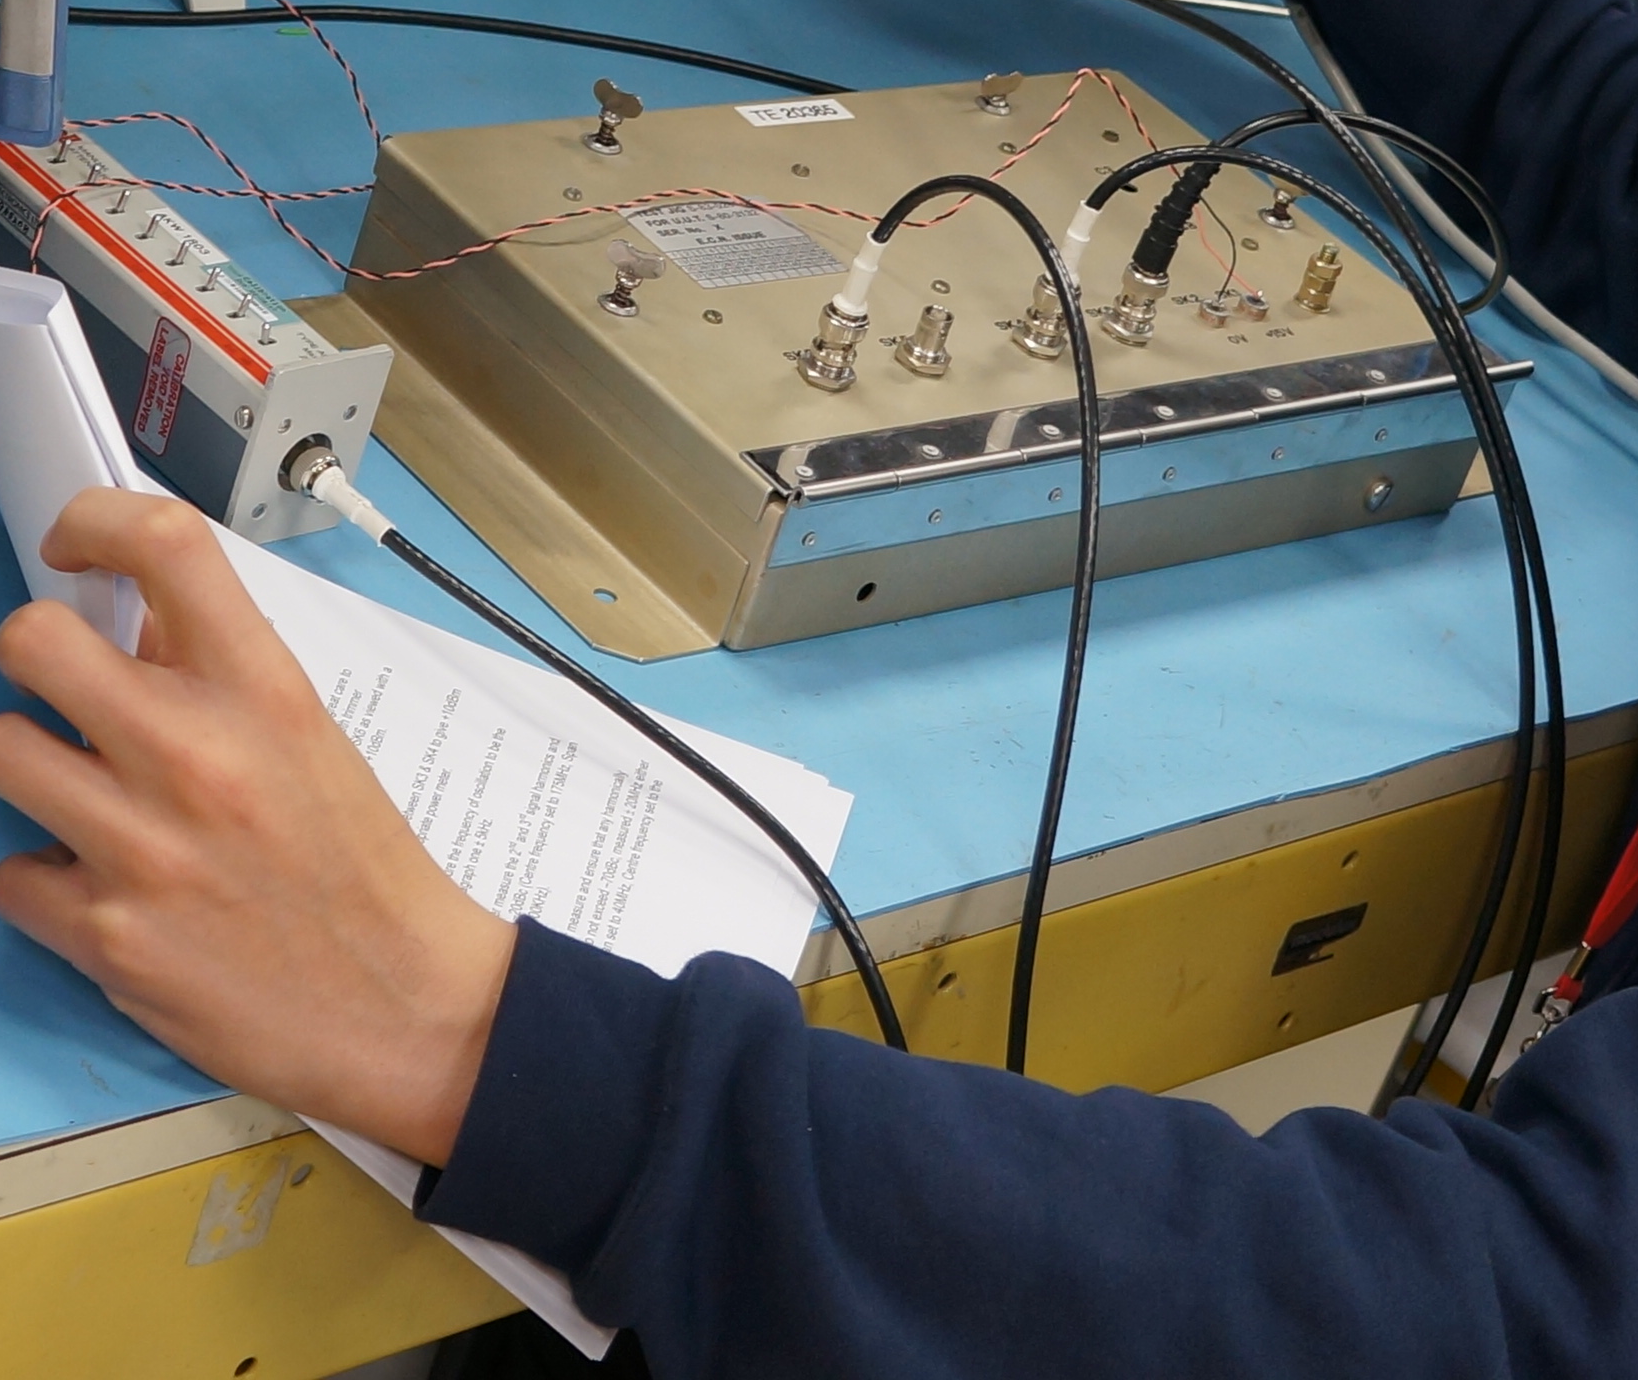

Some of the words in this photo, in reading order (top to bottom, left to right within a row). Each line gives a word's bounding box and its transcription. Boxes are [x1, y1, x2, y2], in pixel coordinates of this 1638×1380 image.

[748, 108, 782, 121] TE
[645, 217, 670, 228] FOR
[731, 231, 767, 242] ISSUE
[152, 328, 169, 367] LABEL
[138, 369, 159, 433] REMOVED
[158, 353, 184, 438] CALIBRATION
[339, 669, 352, 677] to
[376, 674, 389, 689] with
[334, 678, 348, 695] care
[342, 689, 362, 719] trimmer
[365, 689, 383, 716] viewed
[442, 689, 461, 719] +10dBm
[360, 718, 371, 728] as
[435, 722, 449, 739] give
[430, 739, 442, 747] to
[492, 728, 506, 741] the
[488, 741, 501, 752] be
[548, 737, 561, 753] and
[422, 747, 438, 764] SK4
[532, 754, 555, 792] harmonics
[634, 760, 649, 781] either
[412, 773, 428, 791] SK3
[473, 761, 494, 798] oscillation
[649, 780, 663, 792] the
[426, 792, 442, 817] power
[469, 798, 479, 808] of
[525, 792, 541, 815] signal
[528, 819, 554, 857] frequency
[545, 805, 557, 818] set
[561, 742, 578, 761] Span
[645, 801, 657, 814] set
[452, 808, 479, 847] frequency
[516, 827, 529, 843] and
[613, 815, 632, 854] measured
[630, 814, 655, 852] frequency
[592, 832, 606, 848] that
[448, 848, 461, 861] the
[469, 848, 482, 863] one
[585, 849, 601, 877] ensure
[505, 857, 519, 870] the
[622, 849, 640, 880] Centre
[494, 871, 514, 907] measure
[579, 877, 592, 894] and
[592, 889, 610, 920] exceed
[567, 895, 586, 932] measure
[609, 915, 621, 925] to
[587, 921, 600, 937] not
[606, 925, 619, 940] set
